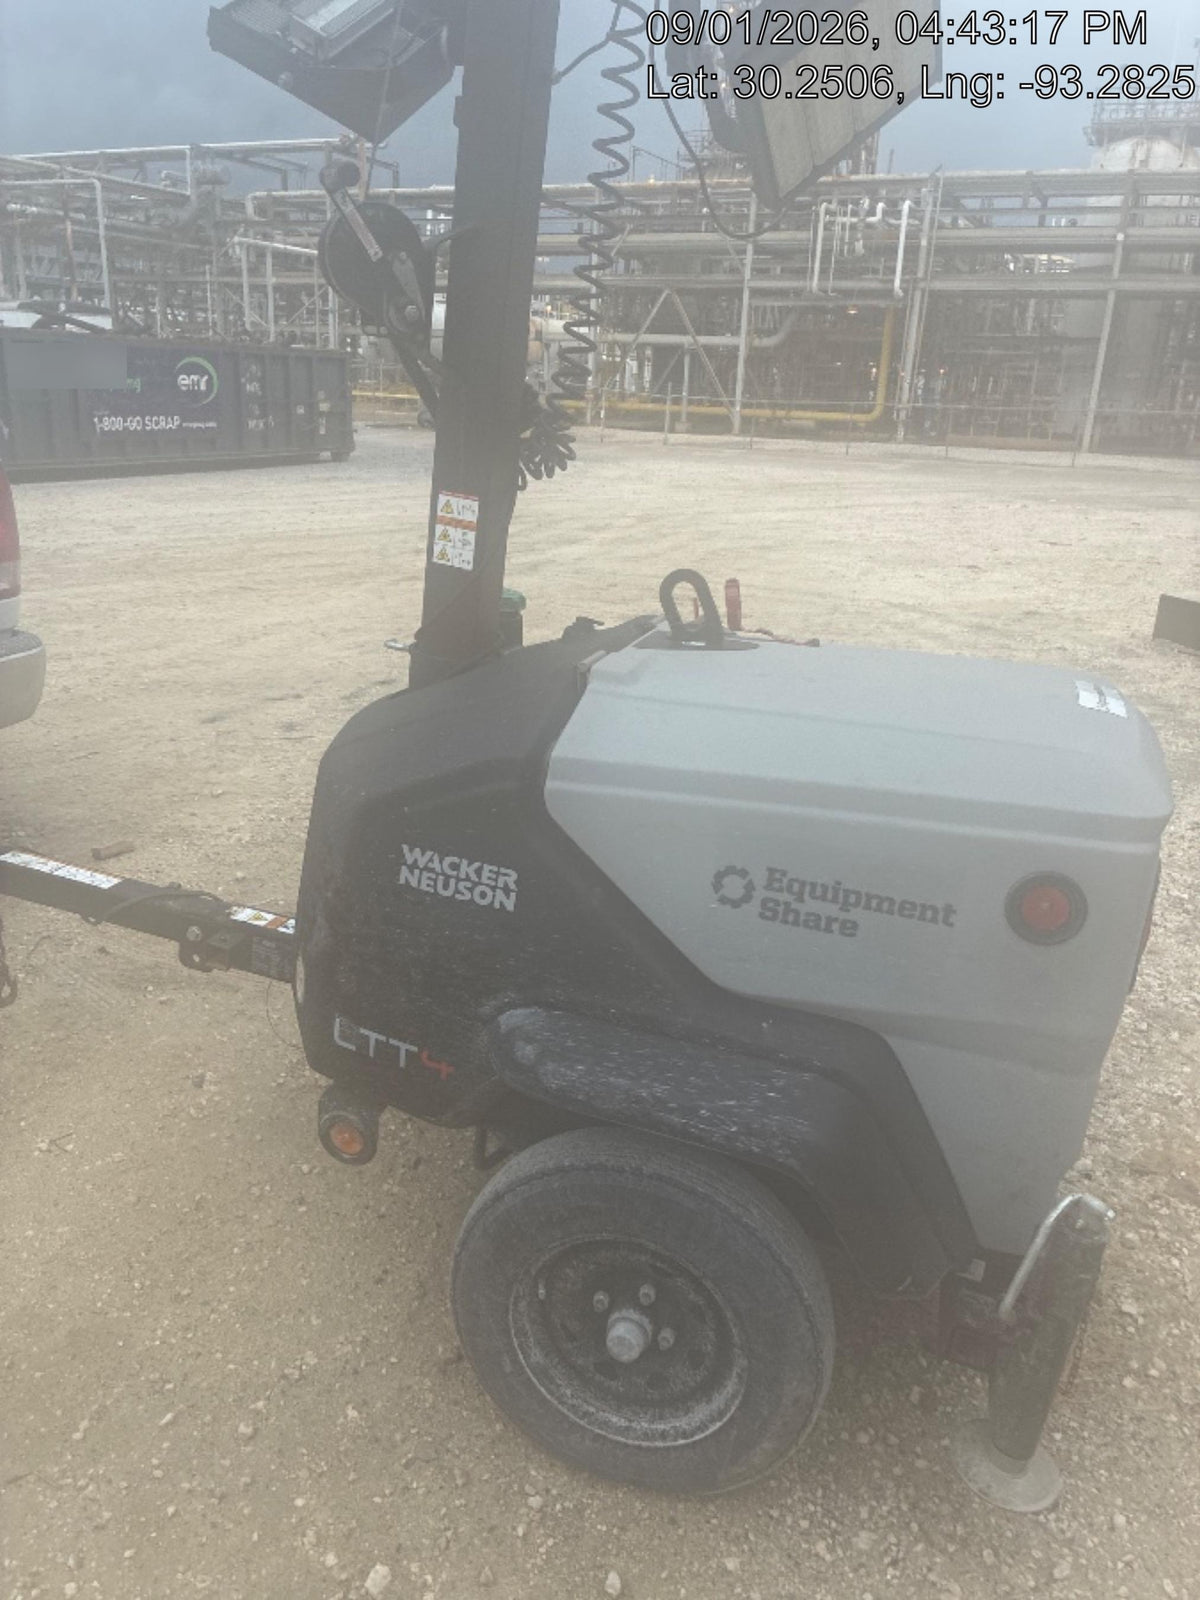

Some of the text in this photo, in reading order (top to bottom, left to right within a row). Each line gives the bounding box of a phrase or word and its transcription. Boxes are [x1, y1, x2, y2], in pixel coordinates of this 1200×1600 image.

[177, 374, 208, 391] emr
[93, 415, 142, 434] 1-800-GO
[145, 415, 180, 430] SCRAP
[399, 865, 517, 912] NEUSON
[401, 844, 518, 891] WACKER
[758, 897, 859, 938] Share
[762, 866, 957, 927] Equipment
[333, 1013, 455, 1080] LTT4
